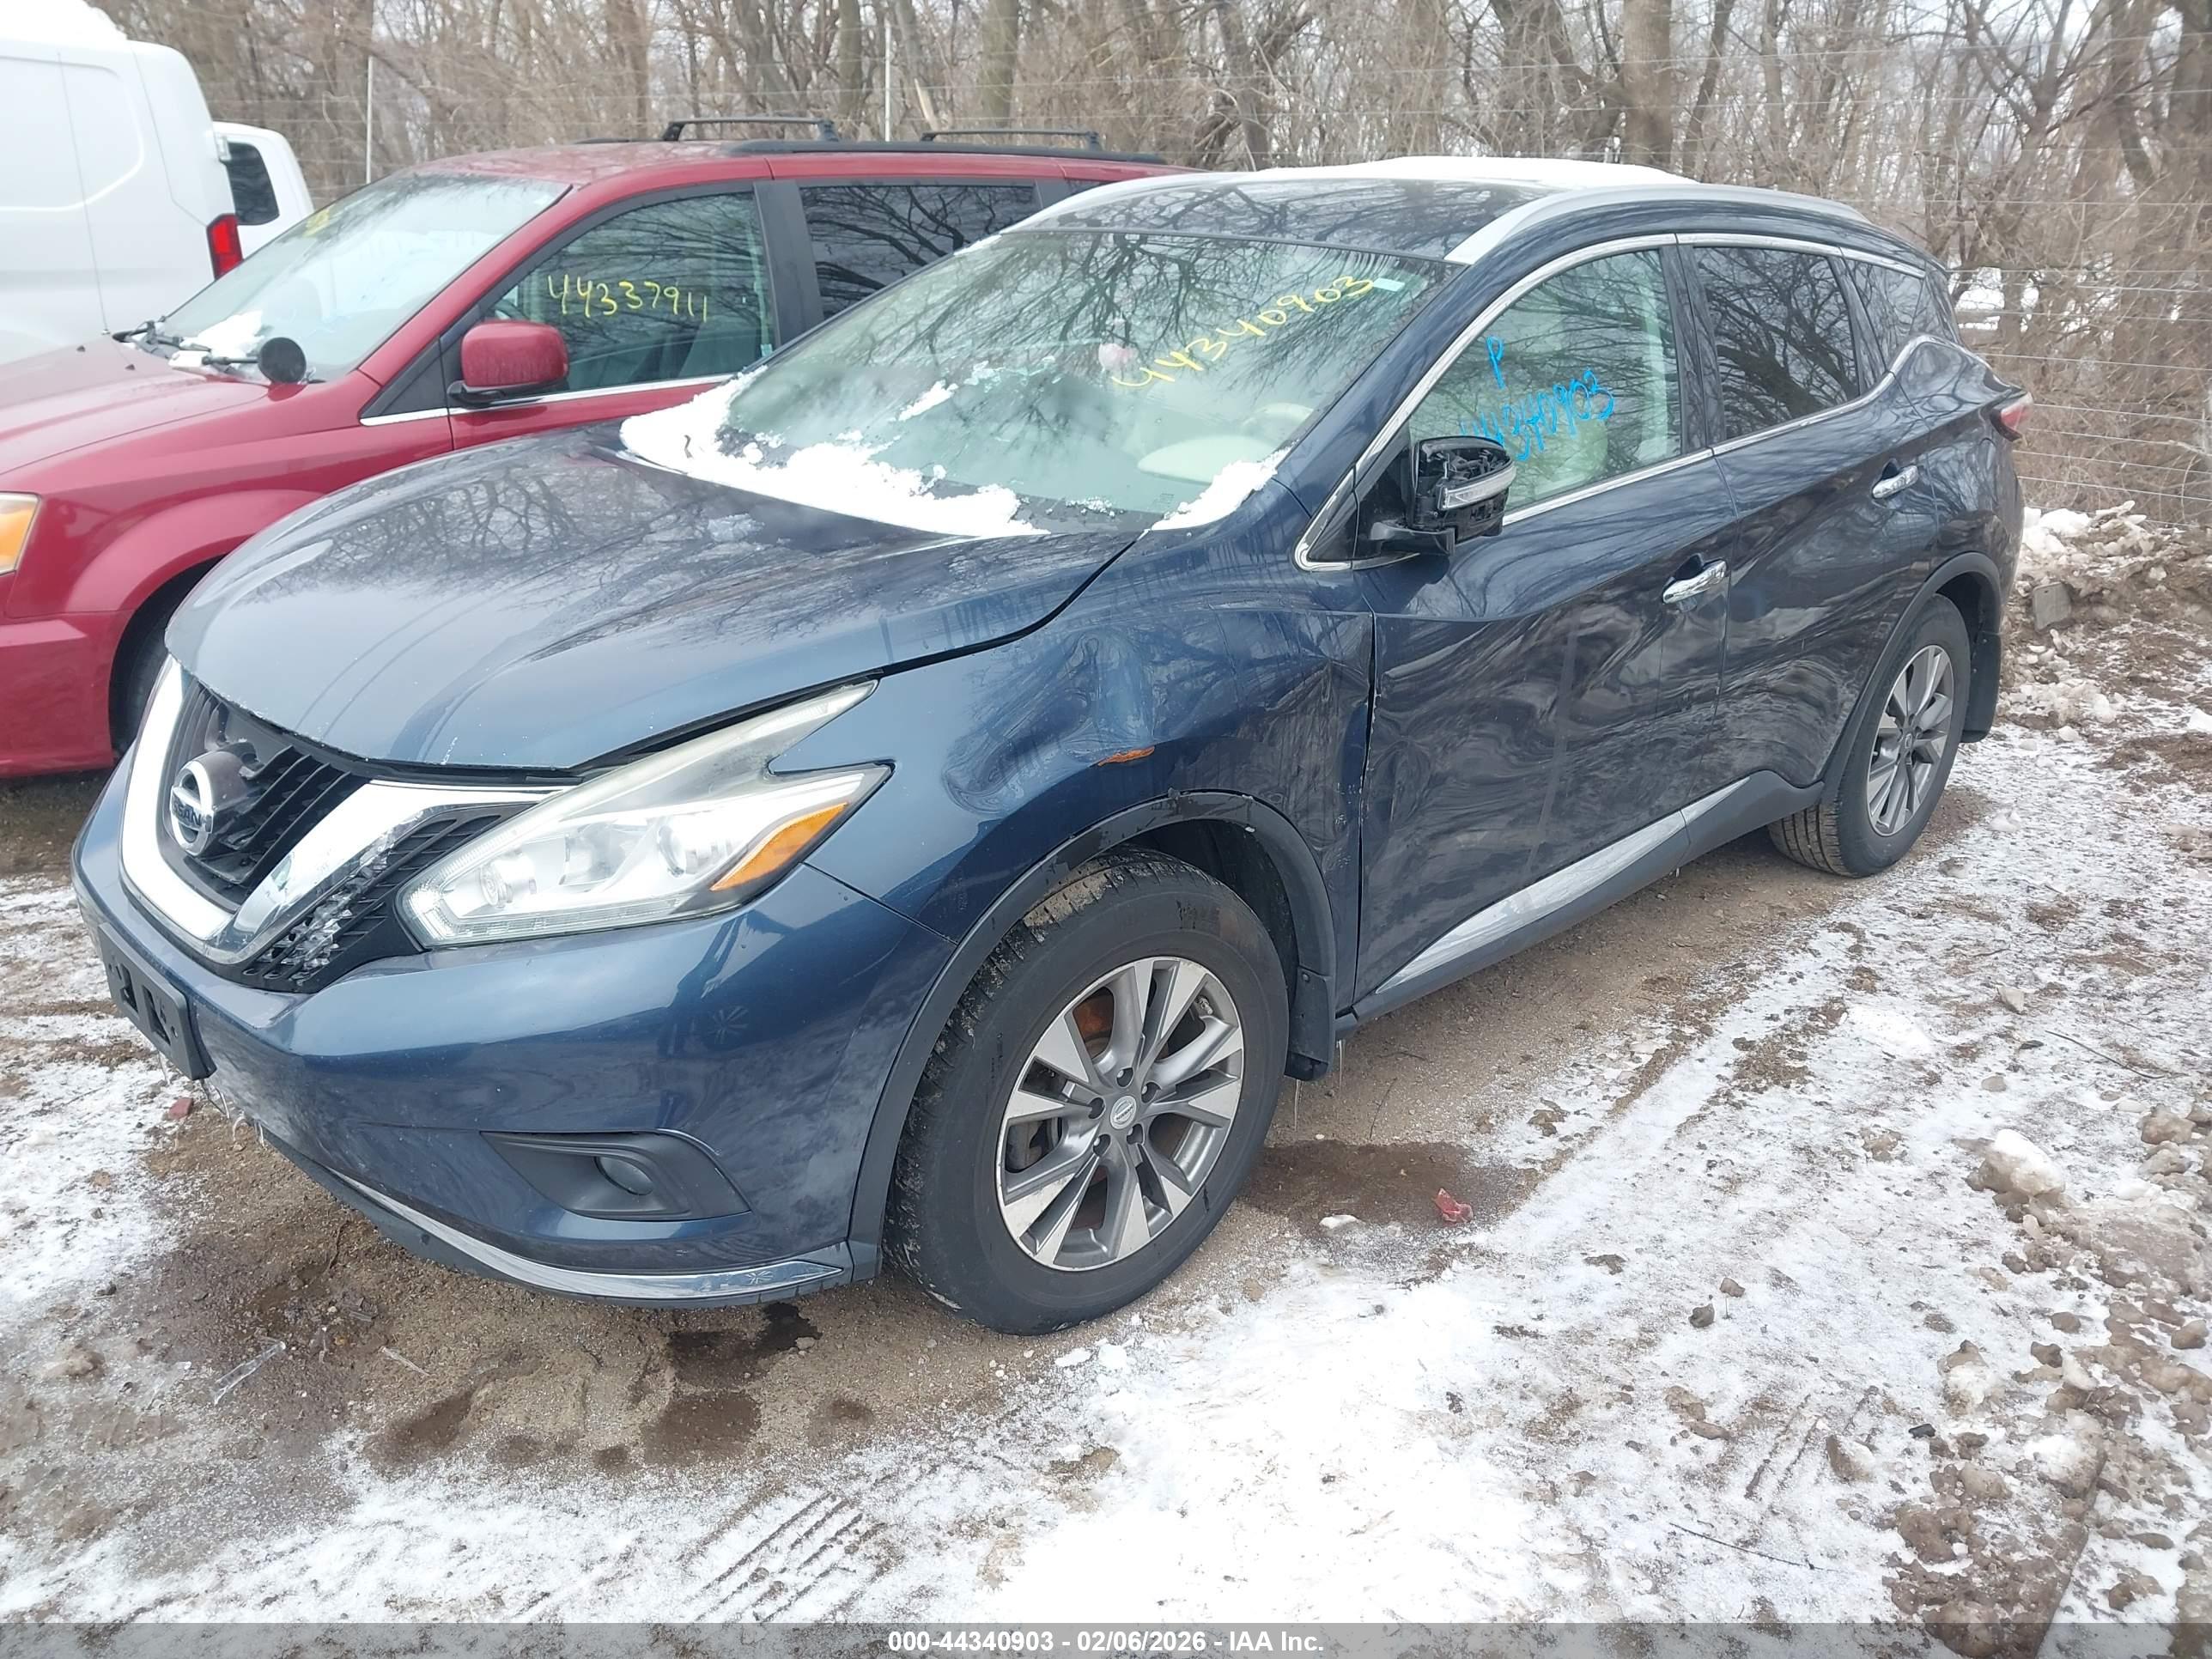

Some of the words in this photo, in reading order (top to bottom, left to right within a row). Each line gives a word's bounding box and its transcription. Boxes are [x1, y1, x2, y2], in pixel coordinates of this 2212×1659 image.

[547, 273, 708, 323] 44337911
[1111, 276, 1374, 388] 44340903
[1486, 336, 1504, 390] P
